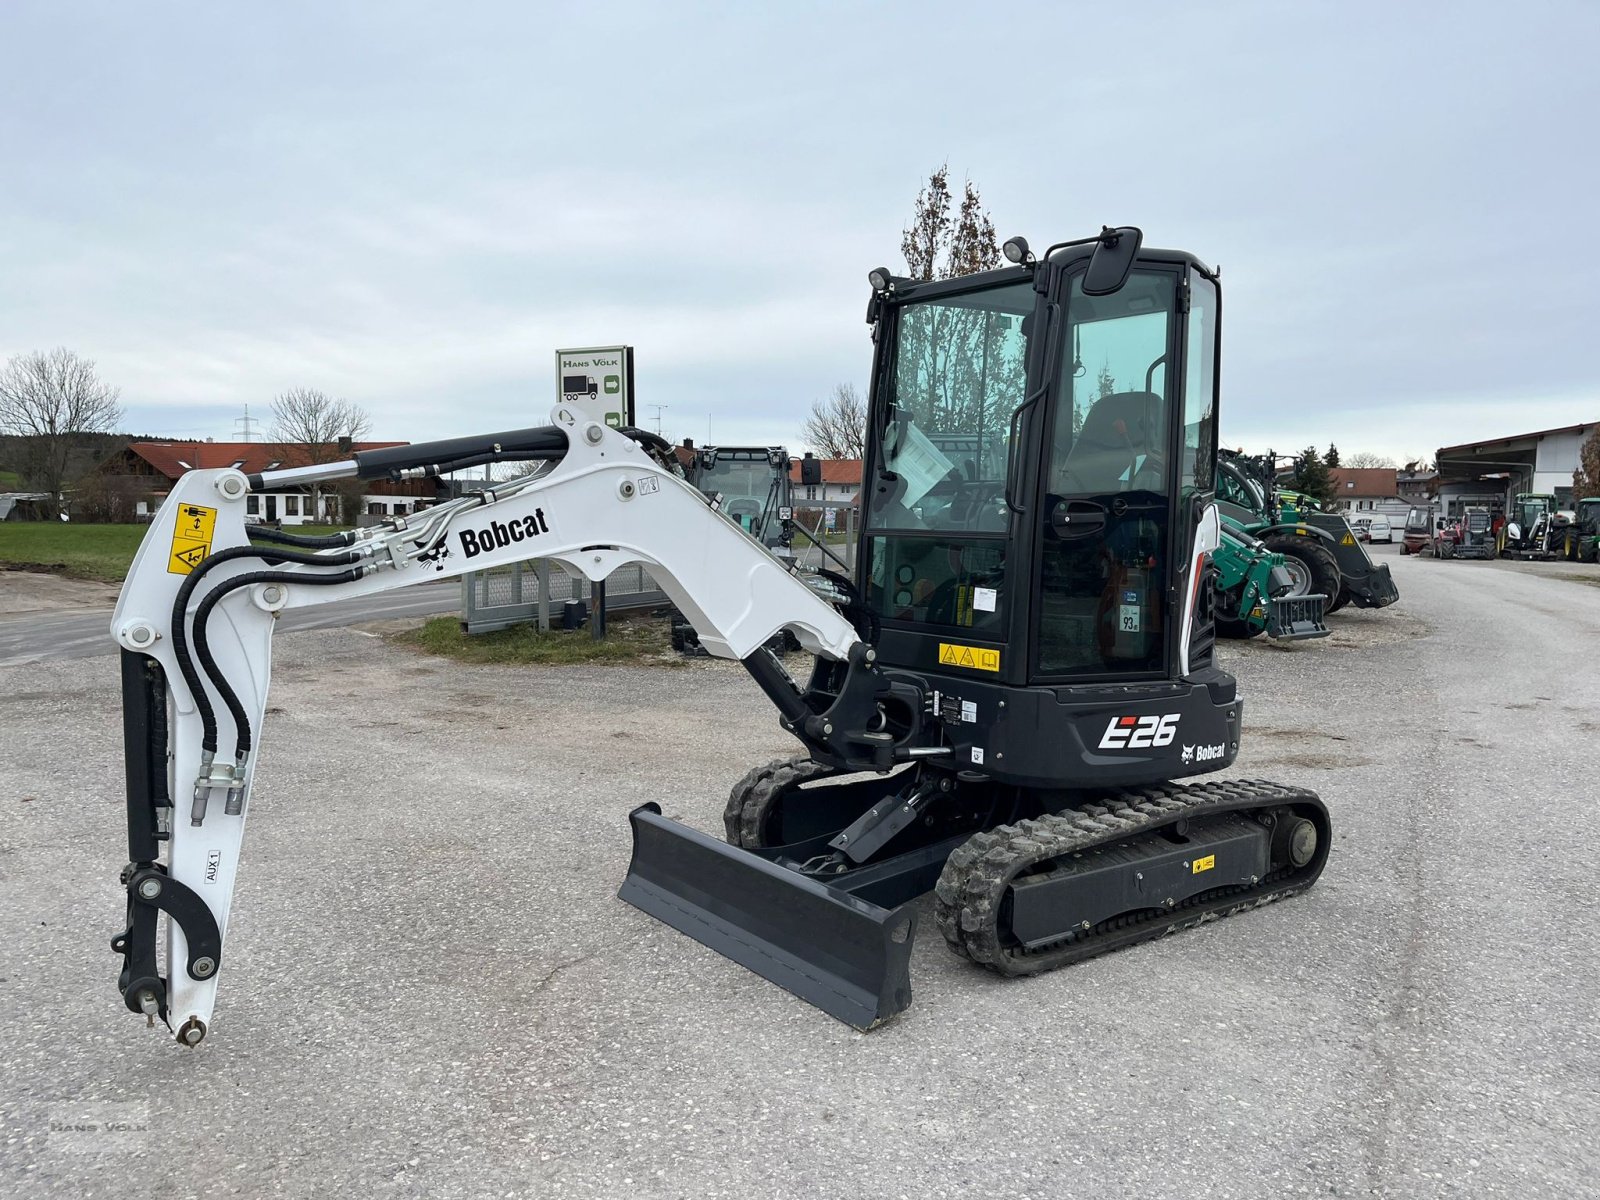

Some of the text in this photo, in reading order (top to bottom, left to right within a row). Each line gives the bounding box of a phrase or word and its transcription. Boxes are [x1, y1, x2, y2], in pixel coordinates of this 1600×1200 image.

[459, 508, 549, 558] Bobcat
[1123, 616, 1134, 630] 93
[1098, 713, 1181, 749] E26
[1196, 742, 1225, 761] Bobcat
[206, 861, 217, 881] AUX
